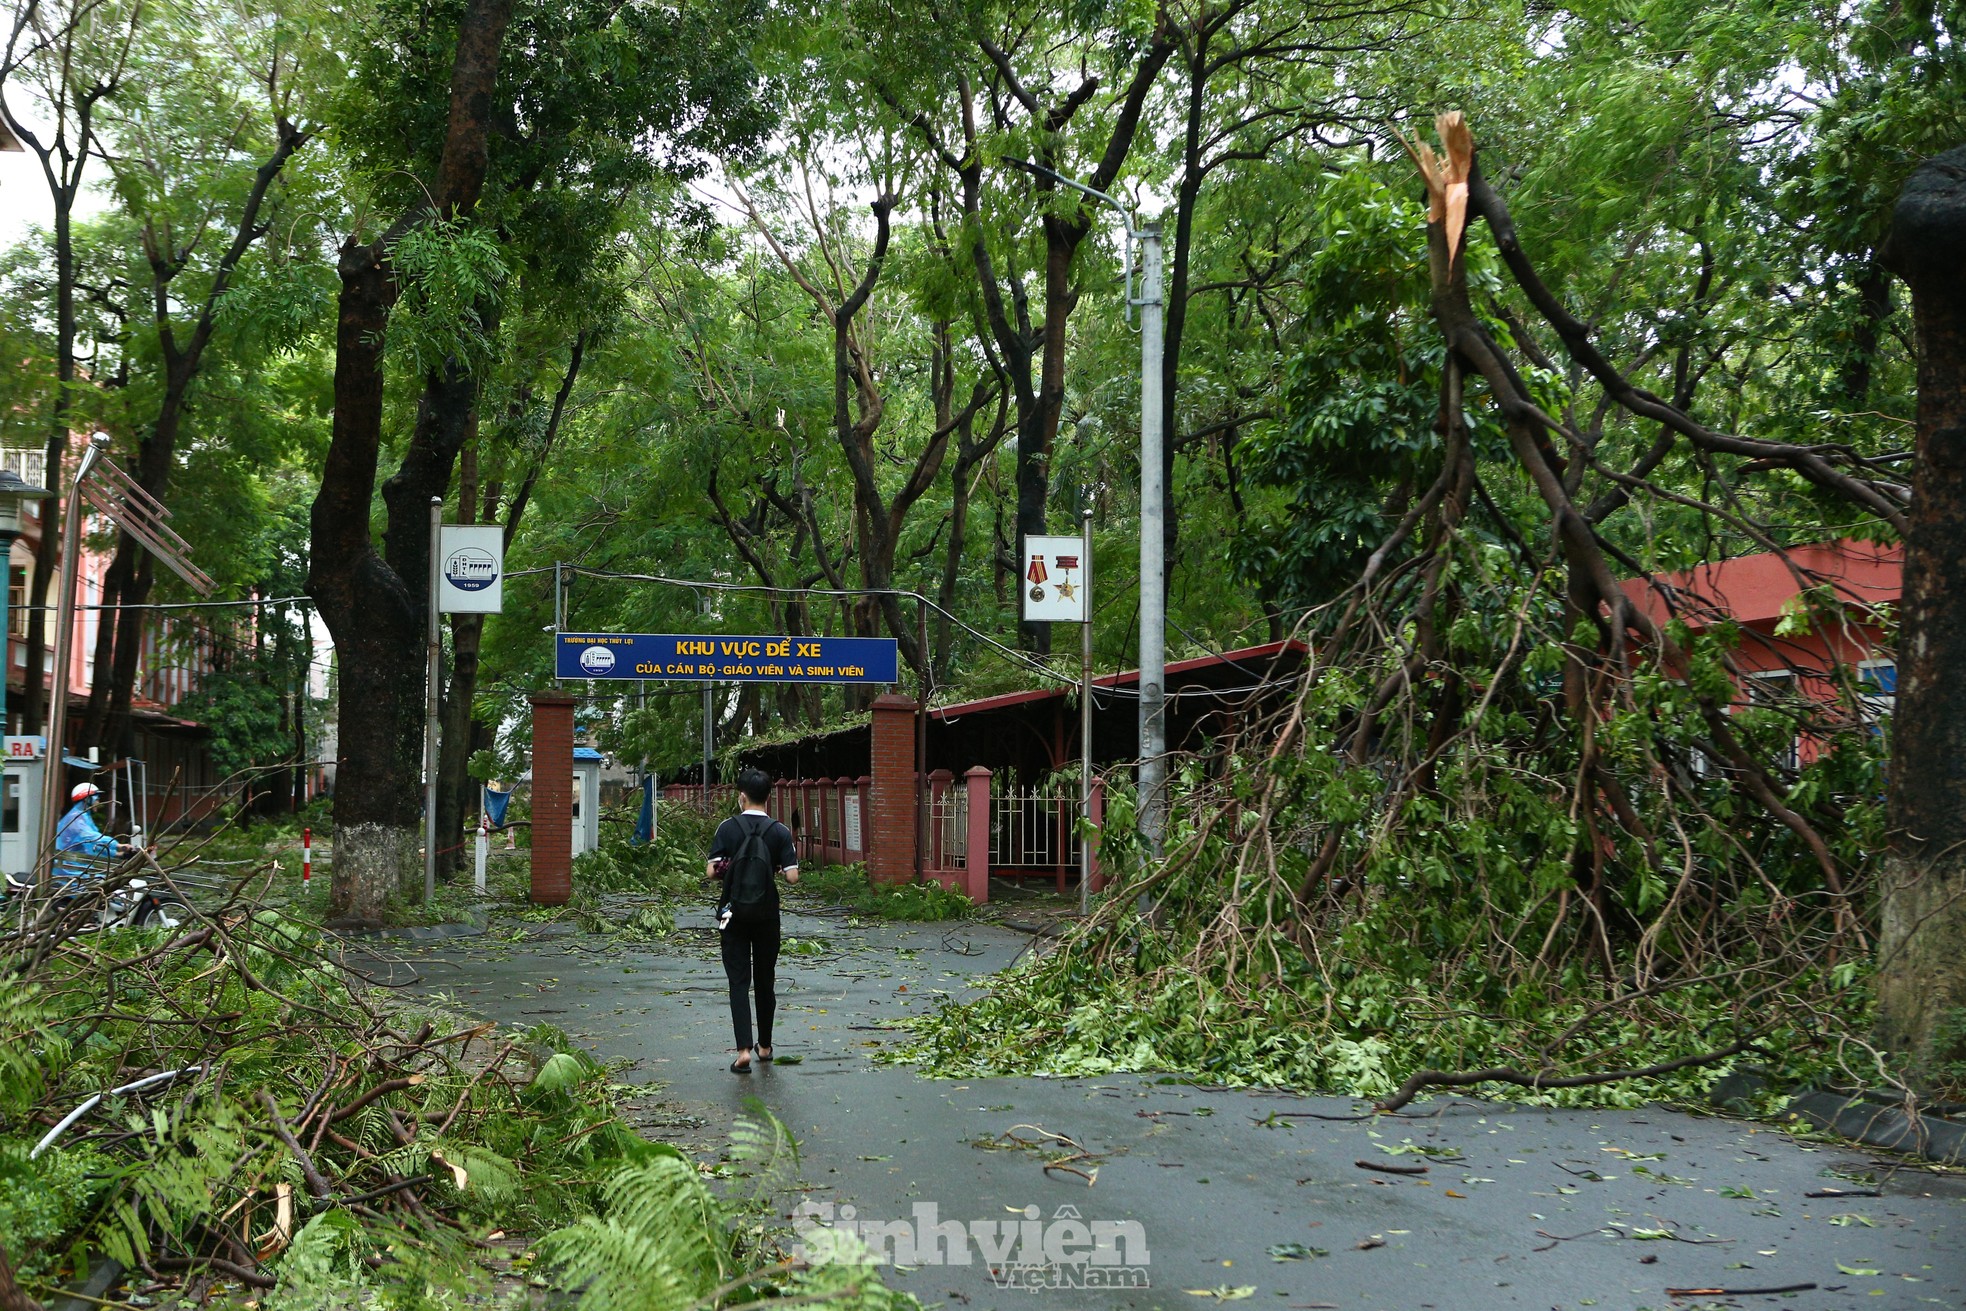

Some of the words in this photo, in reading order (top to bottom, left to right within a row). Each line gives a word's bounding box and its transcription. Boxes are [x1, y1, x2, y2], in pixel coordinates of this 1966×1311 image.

[564, 635, 586, 644] TRƯỜNG
[597, 637, 609, 645] HỌC
[676, 641, 715, 655] KHU
[720, 640, 761, 659] VỰC
[765, 636, 792, 657] ĐỂ
[796, 643, 821, 657] XE
[635, 660, 662, 674] CỦA
[666, 662, 694, 674] CÁN
[756, 664, 784, 675] VIÊN
[788, 664, 804, 676] VÀ
[807, 666, 834, 676] SINH
[837, 665, 864, 676] VIÊN
[11, 742, 33, 756] RA
